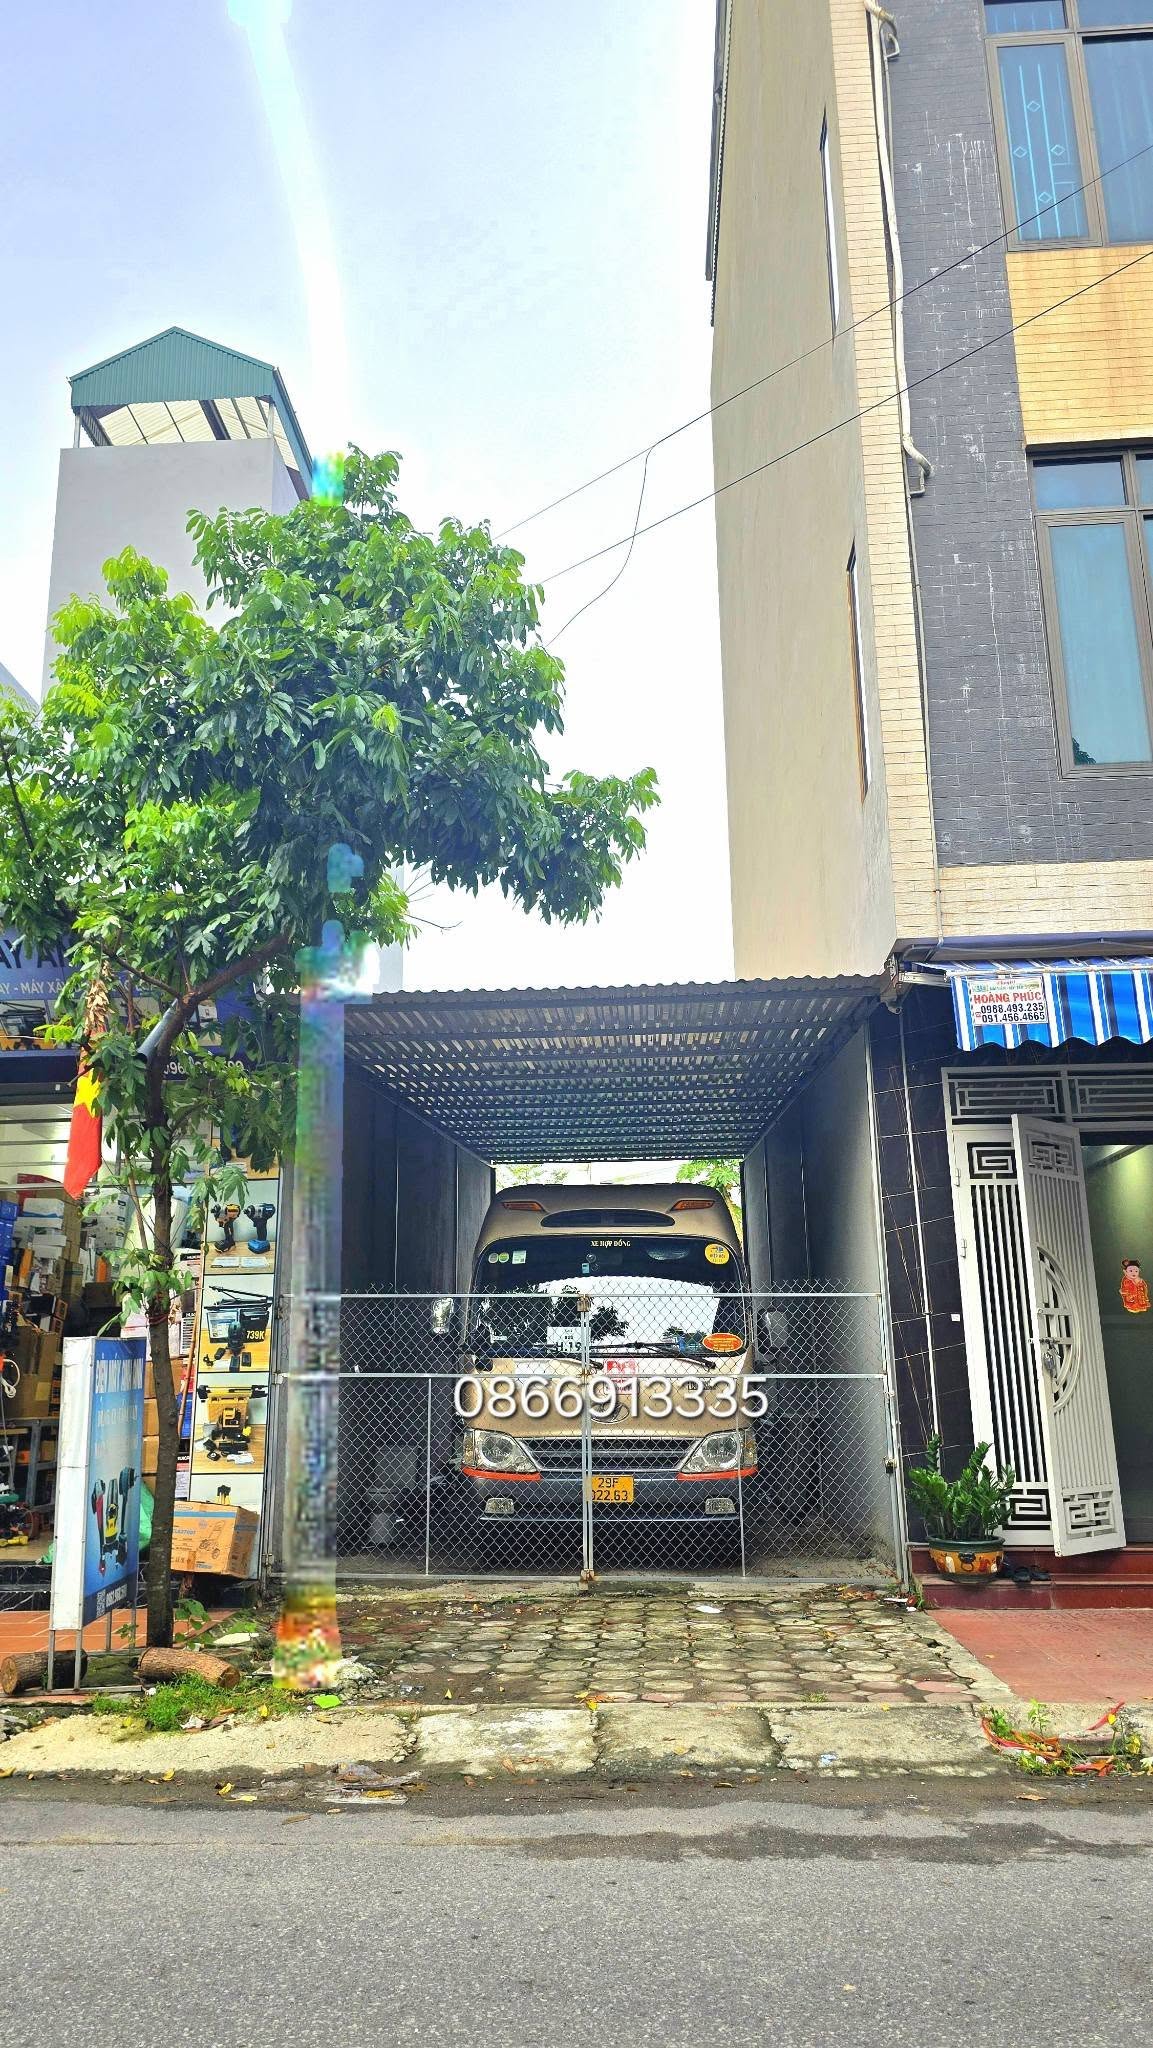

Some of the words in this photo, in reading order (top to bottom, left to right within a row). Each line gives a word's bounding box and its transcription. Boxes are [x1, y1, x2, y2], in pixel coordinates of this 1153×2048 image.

[973, 991, 1010, 1004] HOÀNG
[1012, 989, 1042, 1002] PHÚC
[982, 1012, 1045, 1023] 091.456.4665
[246, 1330, 265, 1340] 739K
[598, 1477, 619, 1488] 29F
